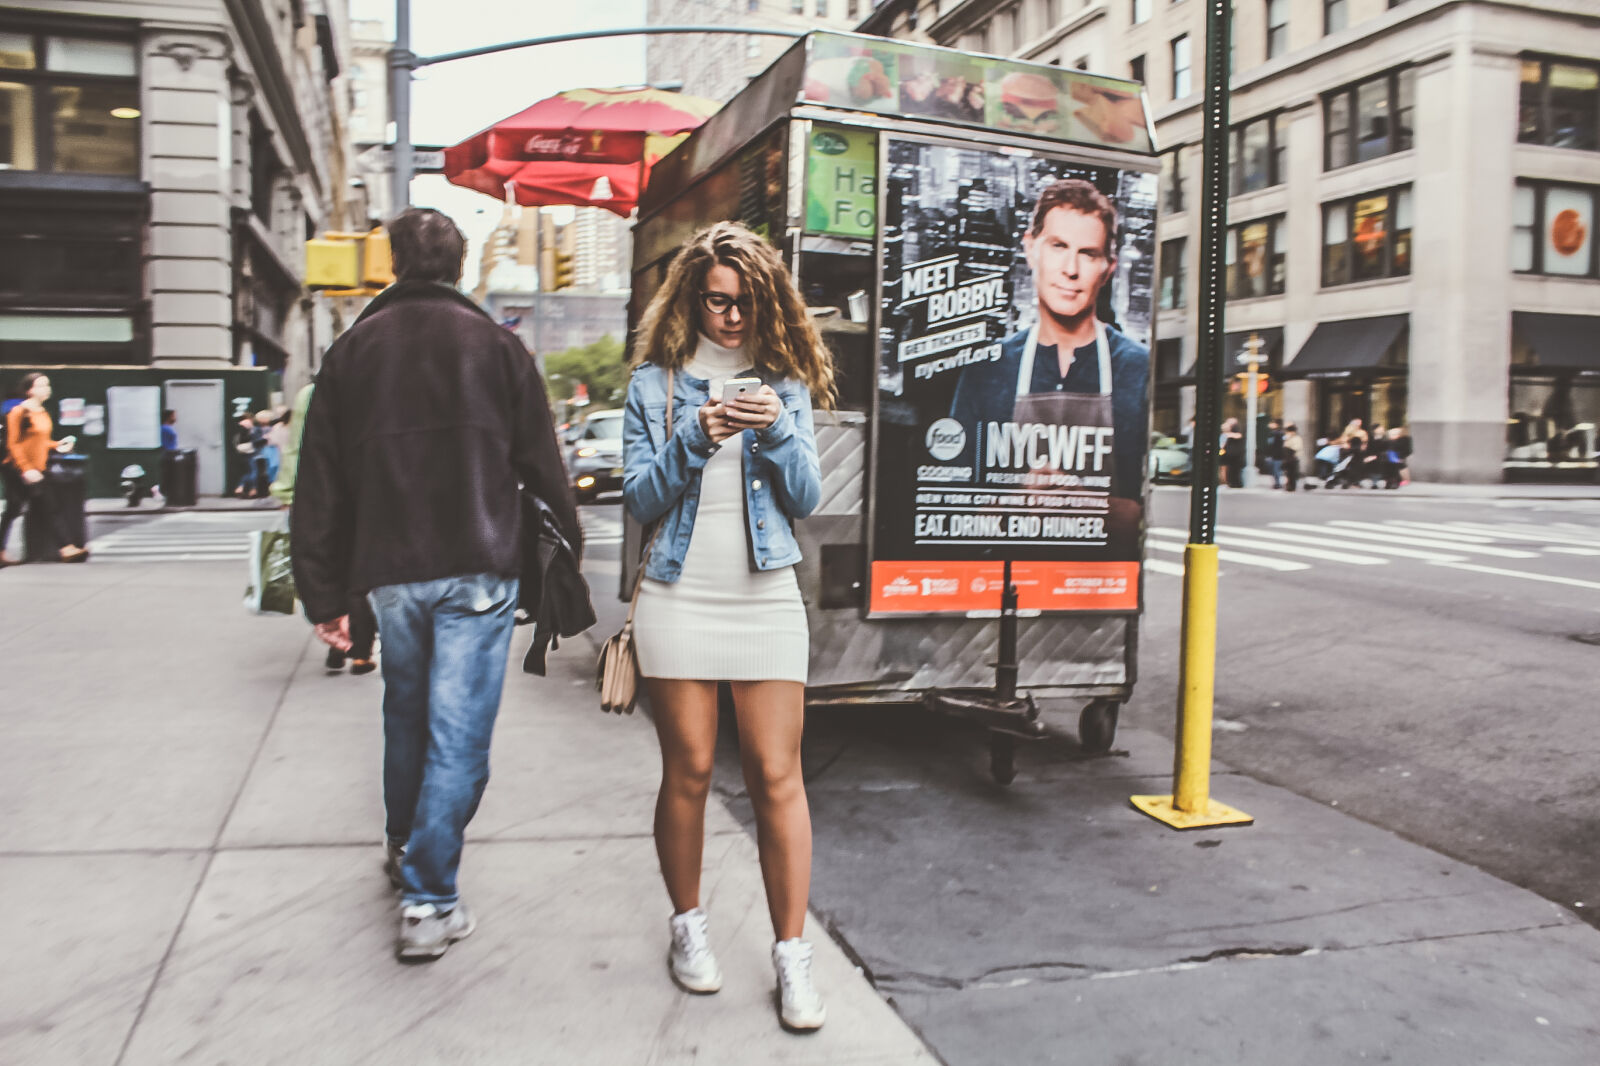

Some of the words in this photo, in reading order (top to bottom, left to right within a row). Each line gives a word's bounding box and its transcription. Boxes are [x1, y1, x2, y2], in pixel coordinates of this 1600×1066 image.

[835, 166, 874, 194] Ha
[835, 200, 875, 228] Fo
[902, 260, 960, 300] MEET
[927, 278, 1008, 323] BOBBY!
[930, 428, 964, 448] food
[986, 421, 1114, 472] NYCWFF
[916, 493, 942, 504] NEW
[943, 494, 972, 505] YORK
[973, 494, 998, 505] CITY
[998, 495, 1026, 506] WINE
[1037, 496, 1064, 507] FOOD
[1064, 496, 1109, 508] FESTIVAL
[915, 514, 949, 537] EAT.
[949, 514, 1007, 537] DRINK.
[1008, 515, 1041, 537] END
[1042, 516, 1108, 538] HUNGER.
